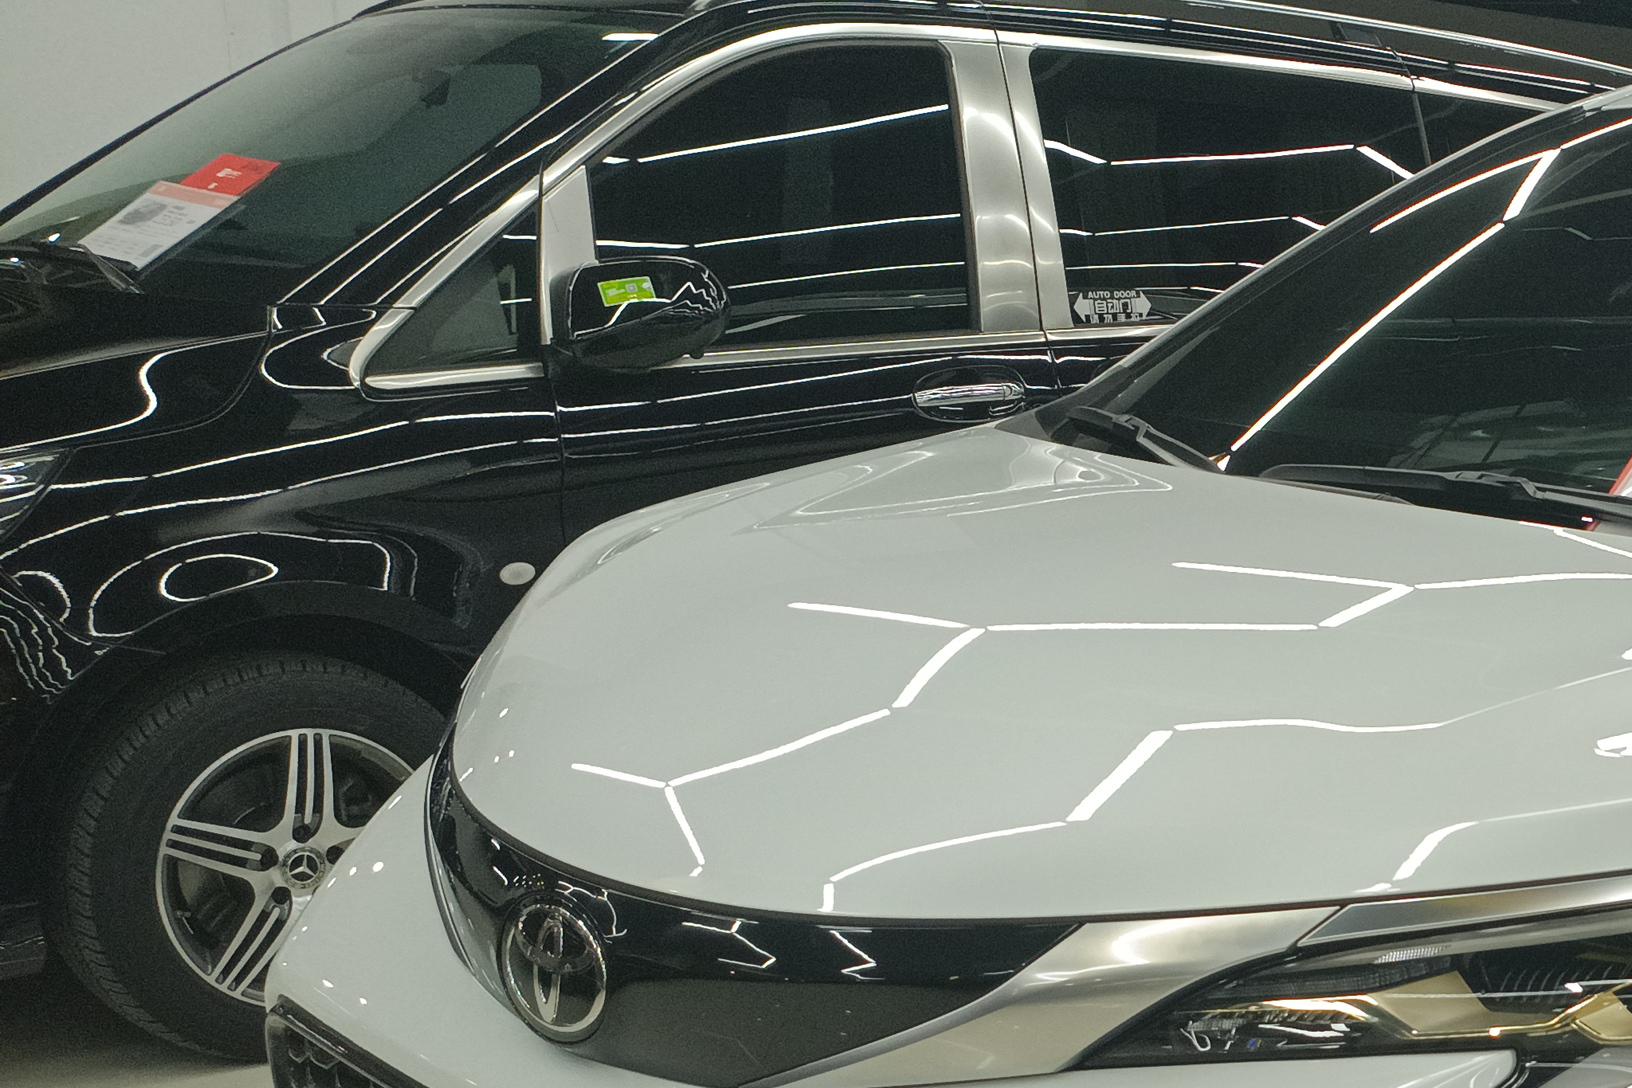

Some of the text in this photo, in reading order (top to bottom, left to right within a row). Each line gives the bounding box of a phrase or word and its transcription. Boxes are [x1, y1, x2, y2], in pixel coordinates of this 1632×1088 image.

[1088, 290, 1137, 299] AUTO DOOR
[1095, 299, 1132, 313] 自动门
